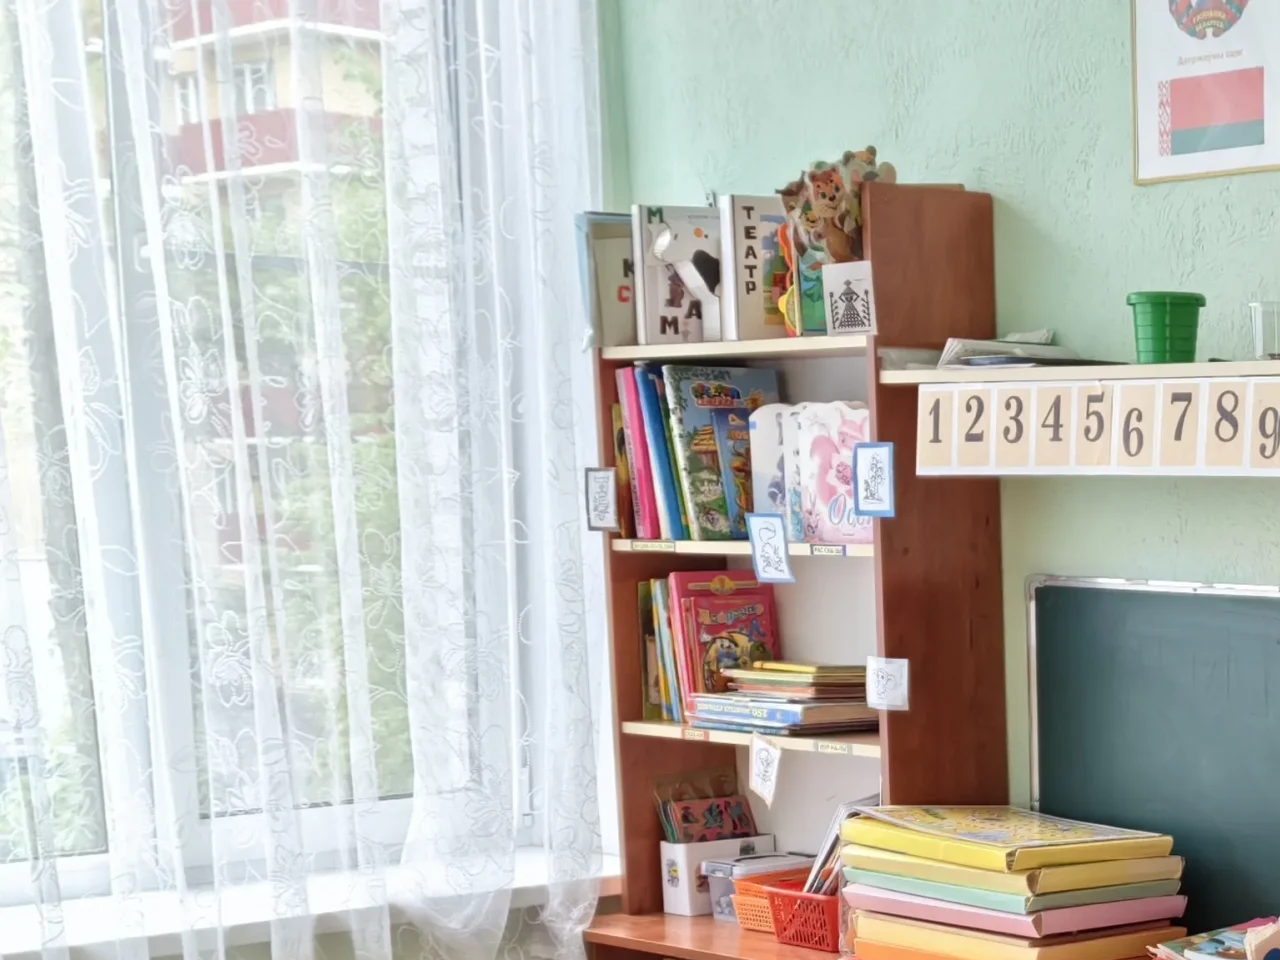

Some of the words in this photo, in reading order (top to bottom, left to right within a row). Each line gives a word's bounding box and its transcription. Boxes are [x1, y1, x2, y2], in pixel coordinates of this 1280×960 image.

[742, 205, 758, 295] ТЕАТР
[928, 397, 943, 444] 1
[964, 394, 985, 443] 2
[1002, 395, 1024, 444] 3
[1041, 394, 1064, 442] 4
[1083, 391, 1105, 442] 5
[1122, 407, 1144, 457] 6
[1170, 391, 1193, 441] 7
[1214, 390, 1239, 442] 8
